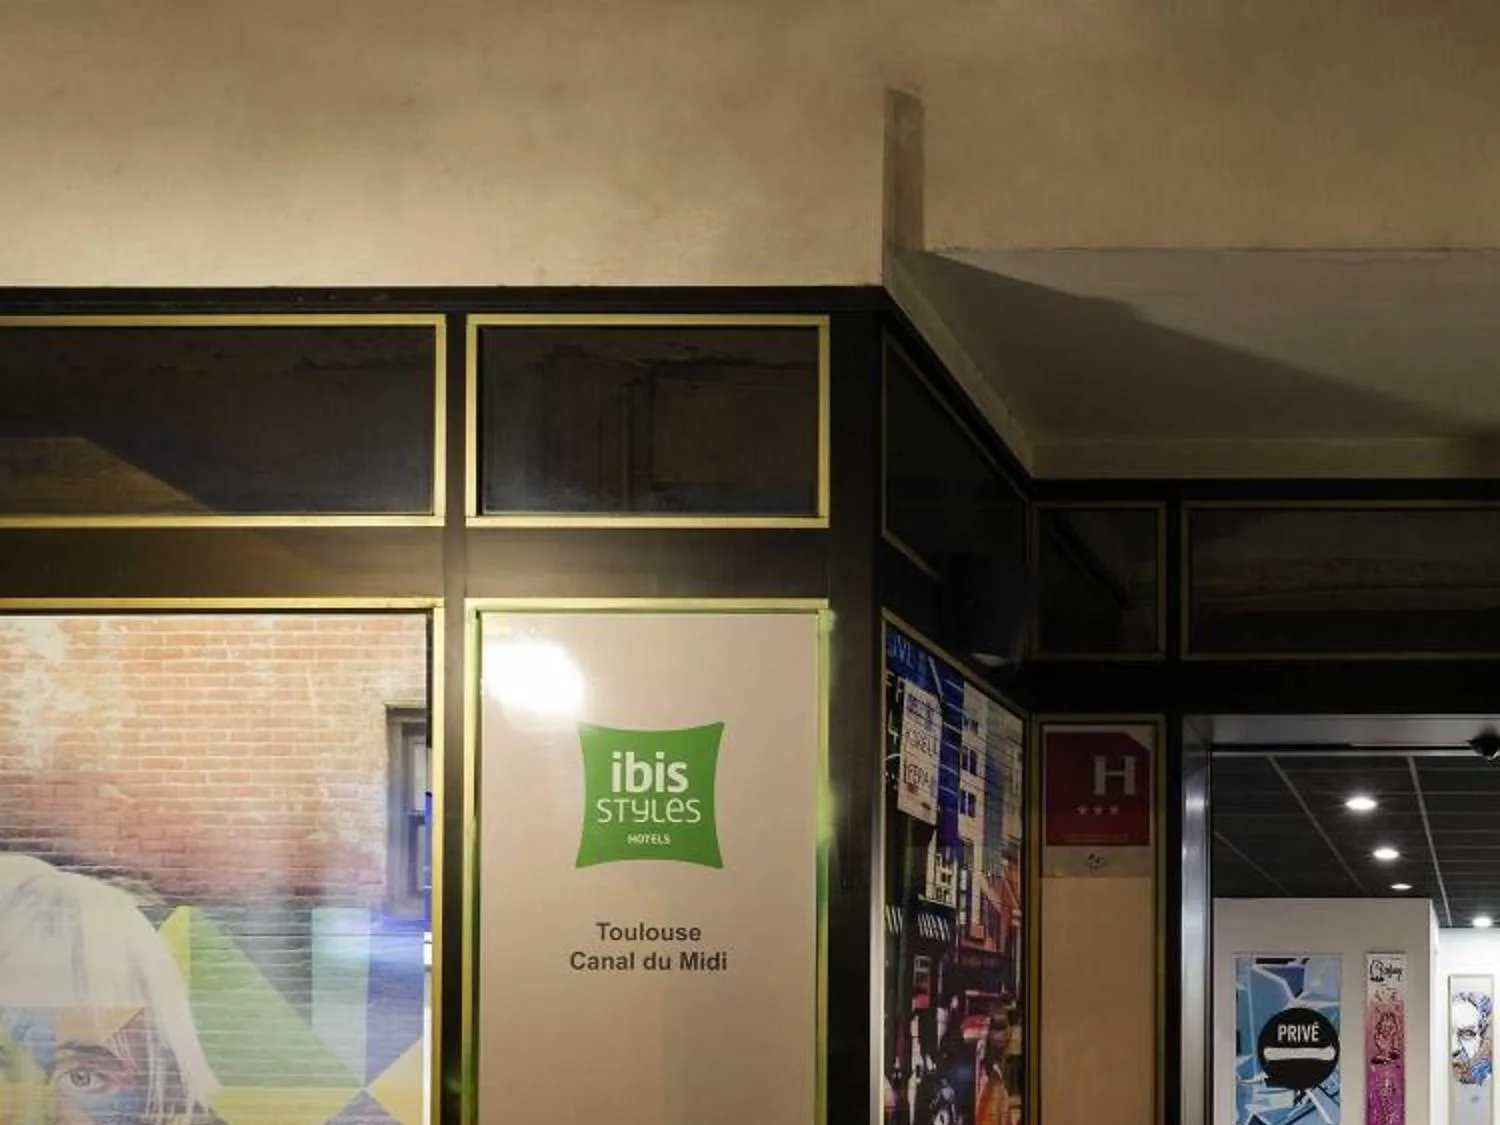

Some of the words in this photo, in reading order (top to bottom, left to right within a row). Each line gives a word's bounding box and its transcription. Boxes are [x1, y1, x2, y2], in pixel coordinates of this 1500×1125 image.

[610, 751, 689, 794] ibis
[1093, 755, 1135, 795] H
[627, 833, 671, 846] HOTELS
[595, 921, 702, 942] Toulouse
[570, 951, 635, 972] Canal
[643, 951, 672, 972] du
[679, 951, 728, 972] Midi
